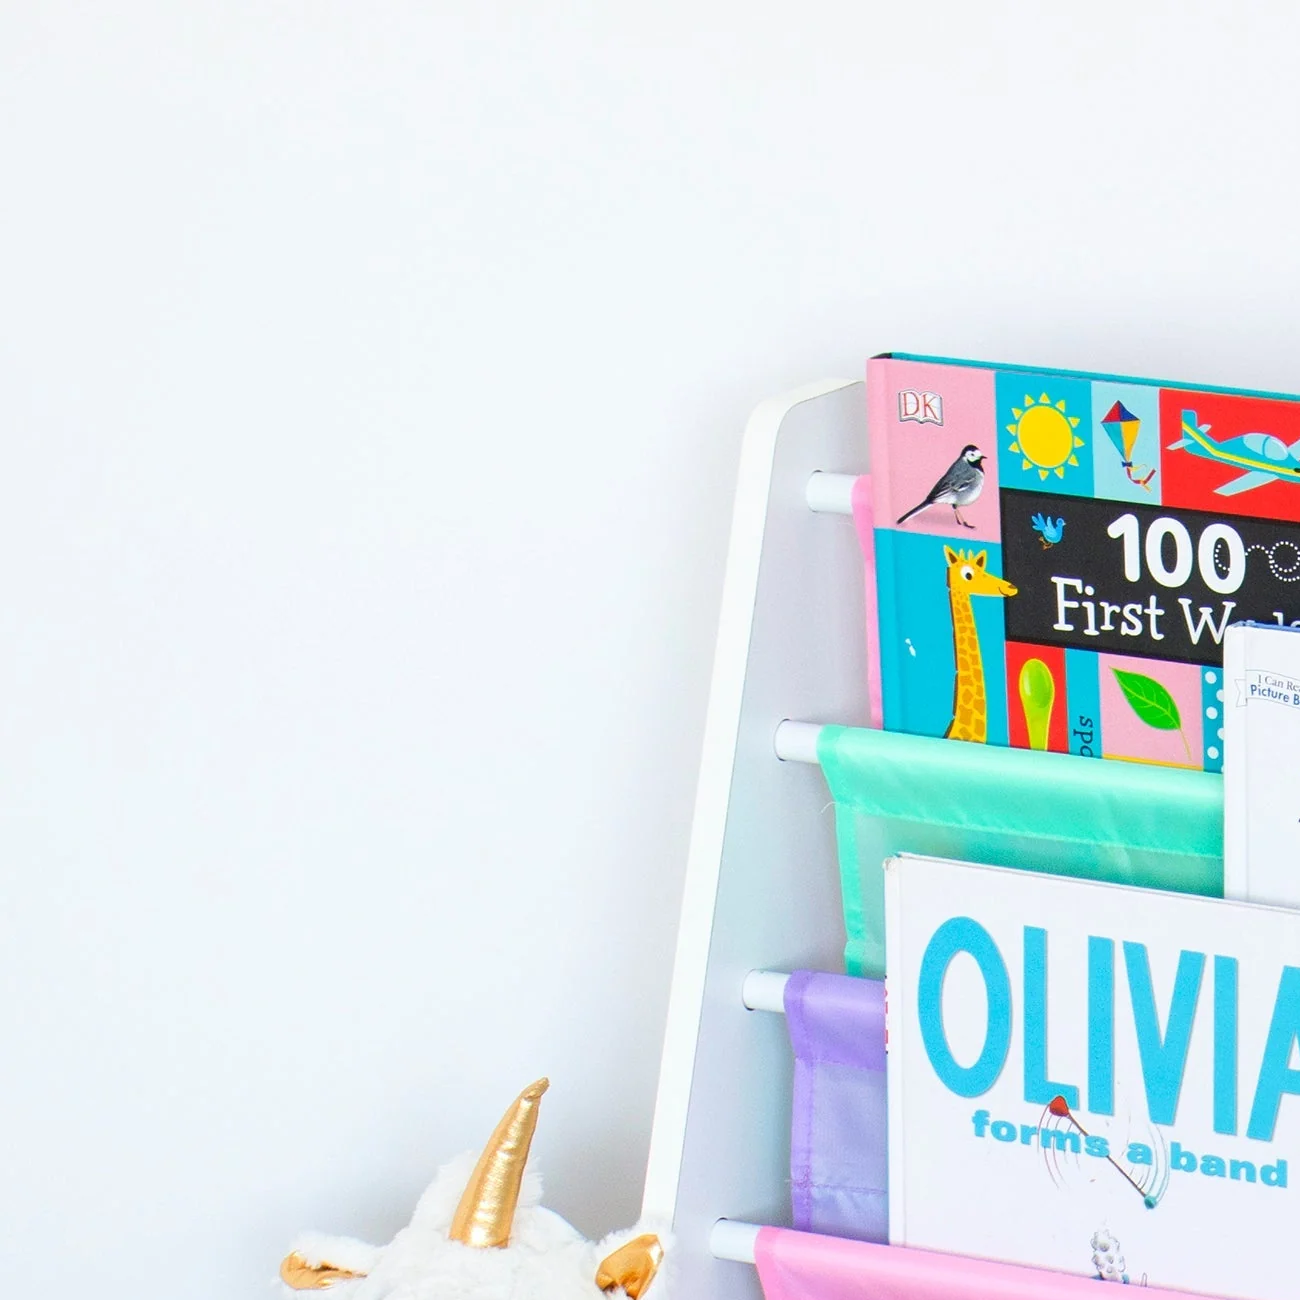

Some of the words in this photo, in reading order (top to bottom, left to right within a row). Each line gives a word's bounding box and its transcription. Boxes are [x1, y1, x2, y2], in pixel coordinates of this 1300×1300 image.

[903, 391, 939, 421] DK
[1107, 513, 1246, 594] 100
[1051, 576, 1165, 640] First
[1250, 684, 1290, 702] Picture
[1264, 675, 1284, 689] Can
[971, 1109, 1110, 1157] forms
[1126, 1141, 1152, 1165] a
[1170, 1141, 1288, 1188] band
